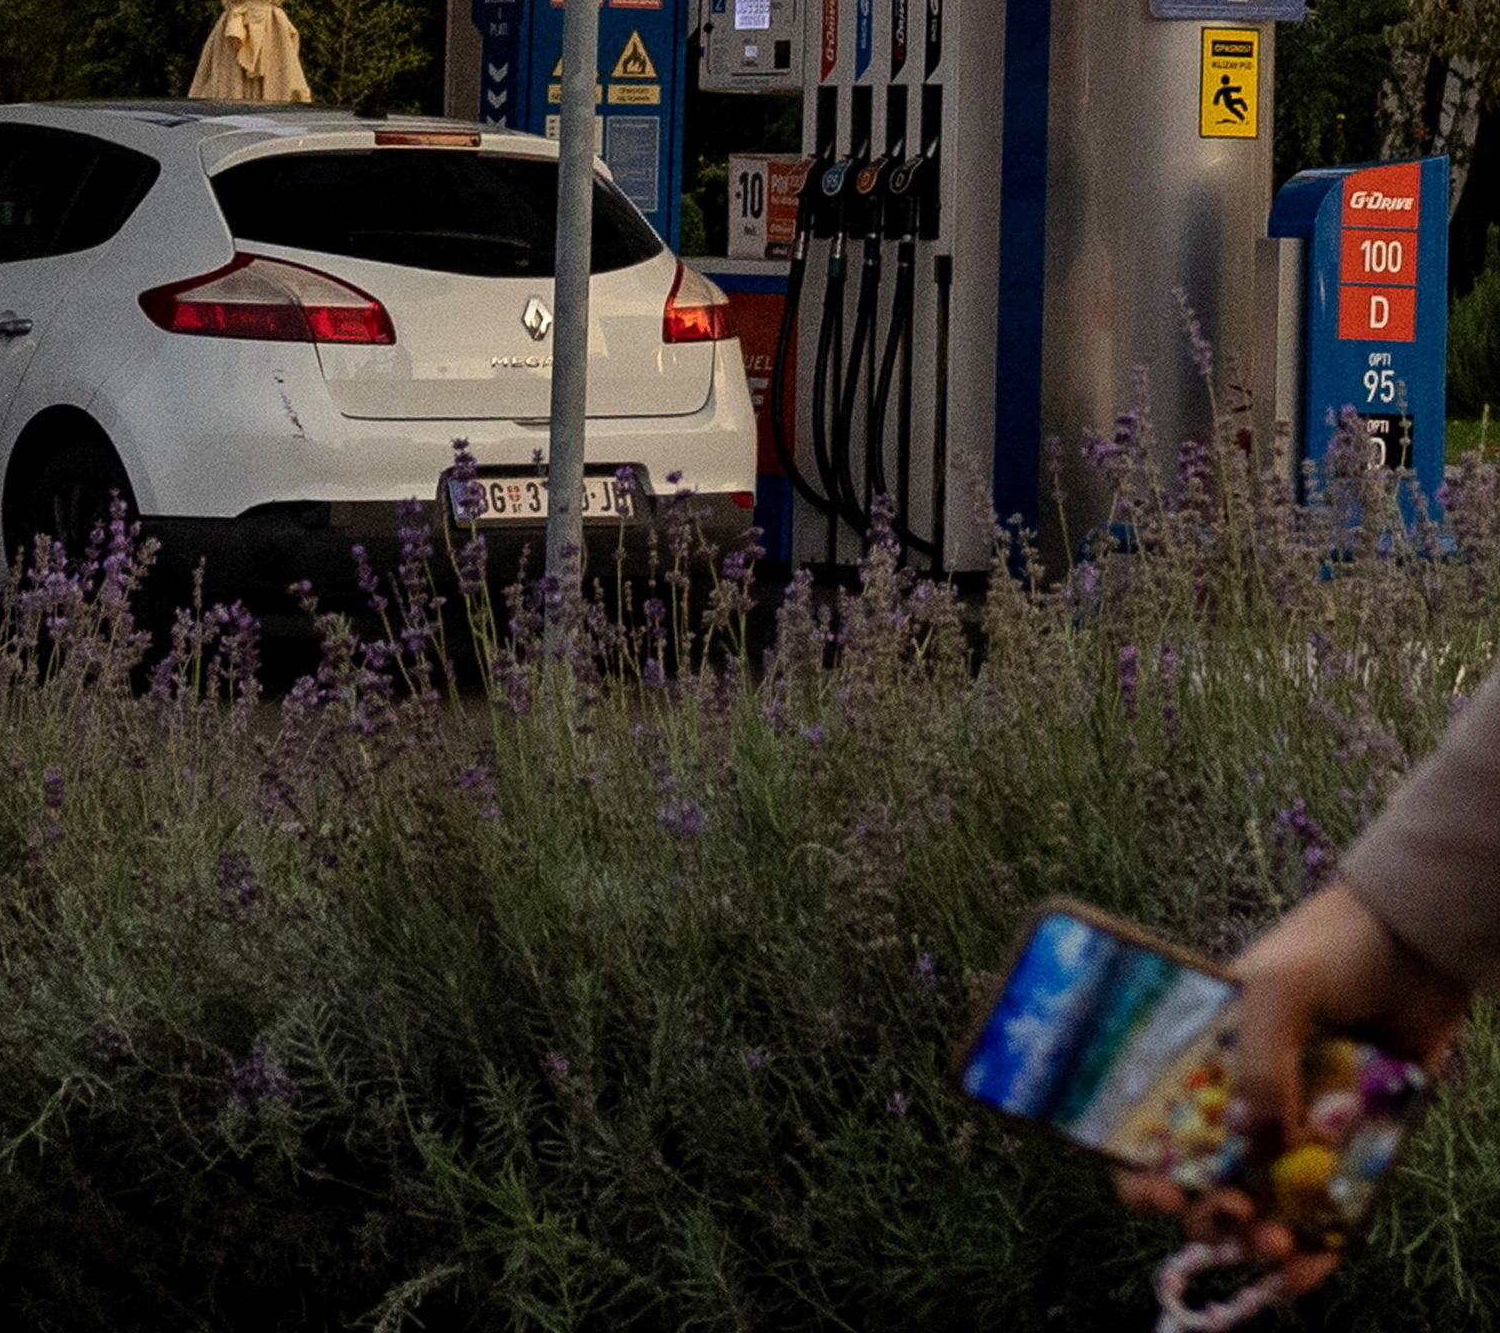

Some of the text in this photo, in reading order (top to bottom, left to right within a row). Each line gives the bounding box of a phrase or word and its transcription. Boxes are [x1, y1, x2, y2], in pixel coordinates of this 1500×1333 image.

[1360, 239, 1403, 274] 100
[1368, 294, 1390, 330] D
[490, 355, 554, 369] MEGA
[1368, 352, 1392, 367] OPTI
[1363, 369, 1395, 404] 95
[1366, 419, 1390, 434] OPTI
